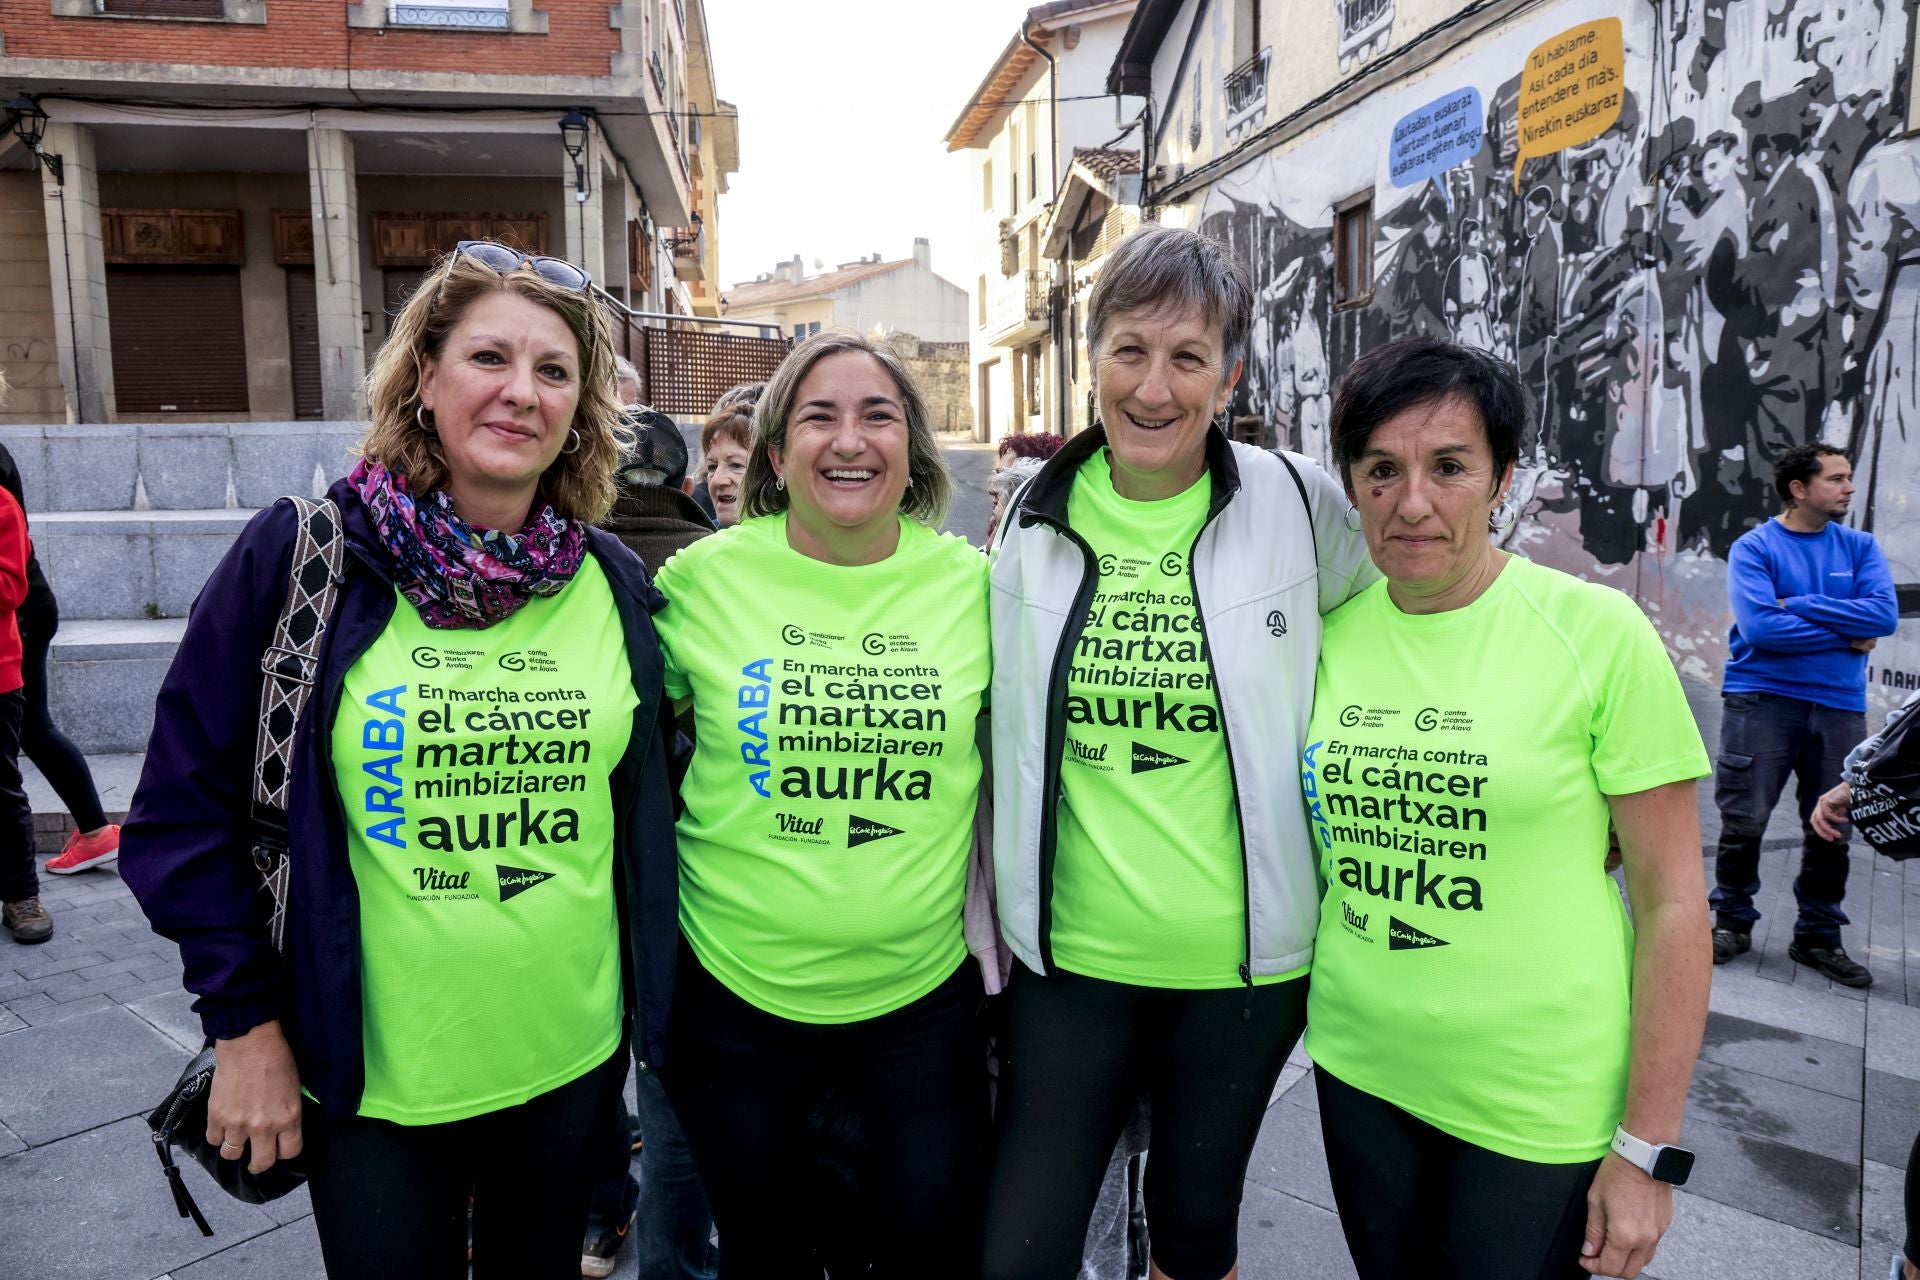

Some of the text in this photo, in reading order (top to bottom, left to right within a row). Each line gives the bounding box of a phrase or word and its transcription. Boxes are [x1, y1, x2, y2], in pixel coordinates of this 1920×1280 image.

[1548, 61, 1575, 85] cada
[1434, 94, 1472, 122] euskaraz
[1565, 93, 1618, 127] euskaraz
[1432, 112, 1466, 140] duenari
[1392, 152, 1425, 177] euskaraz
[1112, 606, 1201, 633] cánce
[783, 659, 939, 677] En marcha contra
[418, 683, 587, 703] En marcha contra
[781, 675, 942, 701] el cáncer
[417, 703, 591, 733] el cáncer
[779, 703, 946, 732] martxan
[1067, 692, 1218, 733] aurka
[738, 658, 774, 798] ARABA
[416, 734, 591, 768] martxan
[778, 730, 943, 757] minbiziaren
[1067, 738, 1107, 761] Vital
[1327, 740, 1488, 766] En marcha contra
[362, 684, 407, 849] ARABA
[780, 757, 932, 801] aurka
[1323, 758, 1488, 798] el cáncer
[415, 770, 586, 799] minbiziaren
[417, 798, 580, 852] aurka
[775, 812, 824, 835] Vital
[1326, 793, 1488, 831] martxan
[1331, 823, 1487, 861] minbiziaren
[413, 867, 470, 891] Vital
[1338, 856, 1483, 911] aurka
[1341, 900, 1369, 931] Vital
